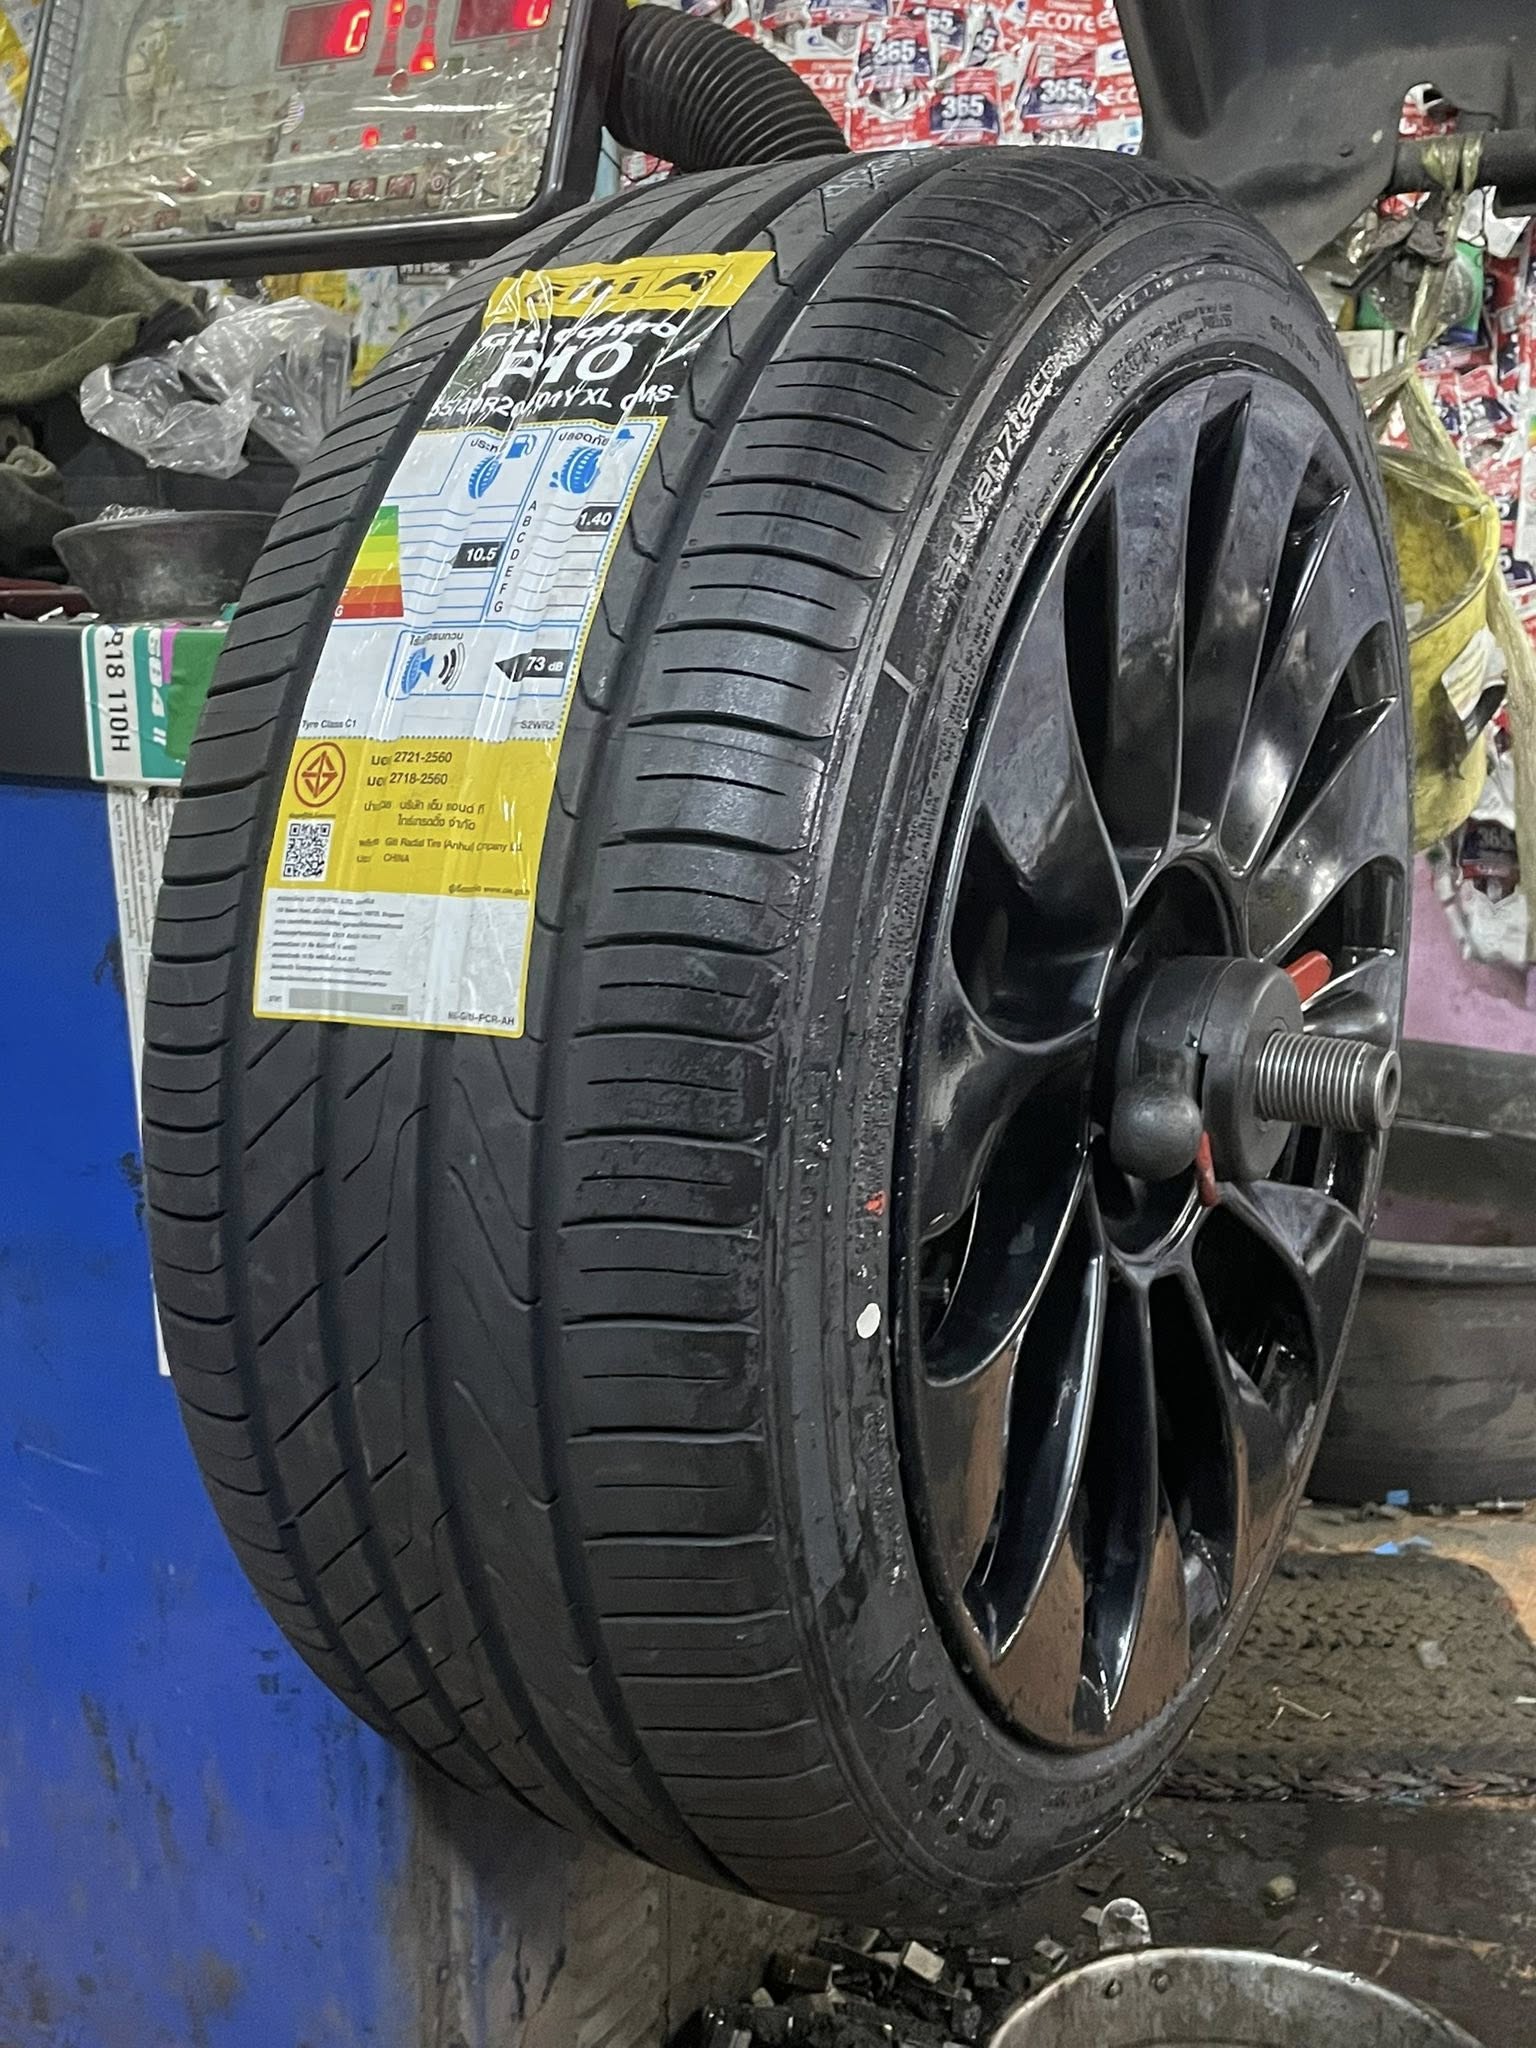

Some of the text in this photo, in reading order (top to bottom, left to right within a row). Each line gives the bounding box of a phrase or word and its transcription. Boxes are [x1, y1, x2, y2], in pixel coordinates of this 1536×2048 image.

[940, 94, 986, 119] 365
[582, 387, 613, 408] XL
[528, 500, 537, 511] A
[522, 511, 612, 527] B 1.40
[516, 531, 526, 543] C
[466, 547, 520, 562] 10.5 D
[505, 565, 514, 578] E
[499, 583, 508, 594] F
[334, 604, 344, 617] G
[494, 600, 504, 612] G
[526, 656, 565, 672] 73 dB
[108, 689, 131, 752] 110H
[302, 718, 357, 730] Tyre Class C1
[393, 751, 453, 764] 2721-2560
[389, 772, 448, 785] 2718-2560
